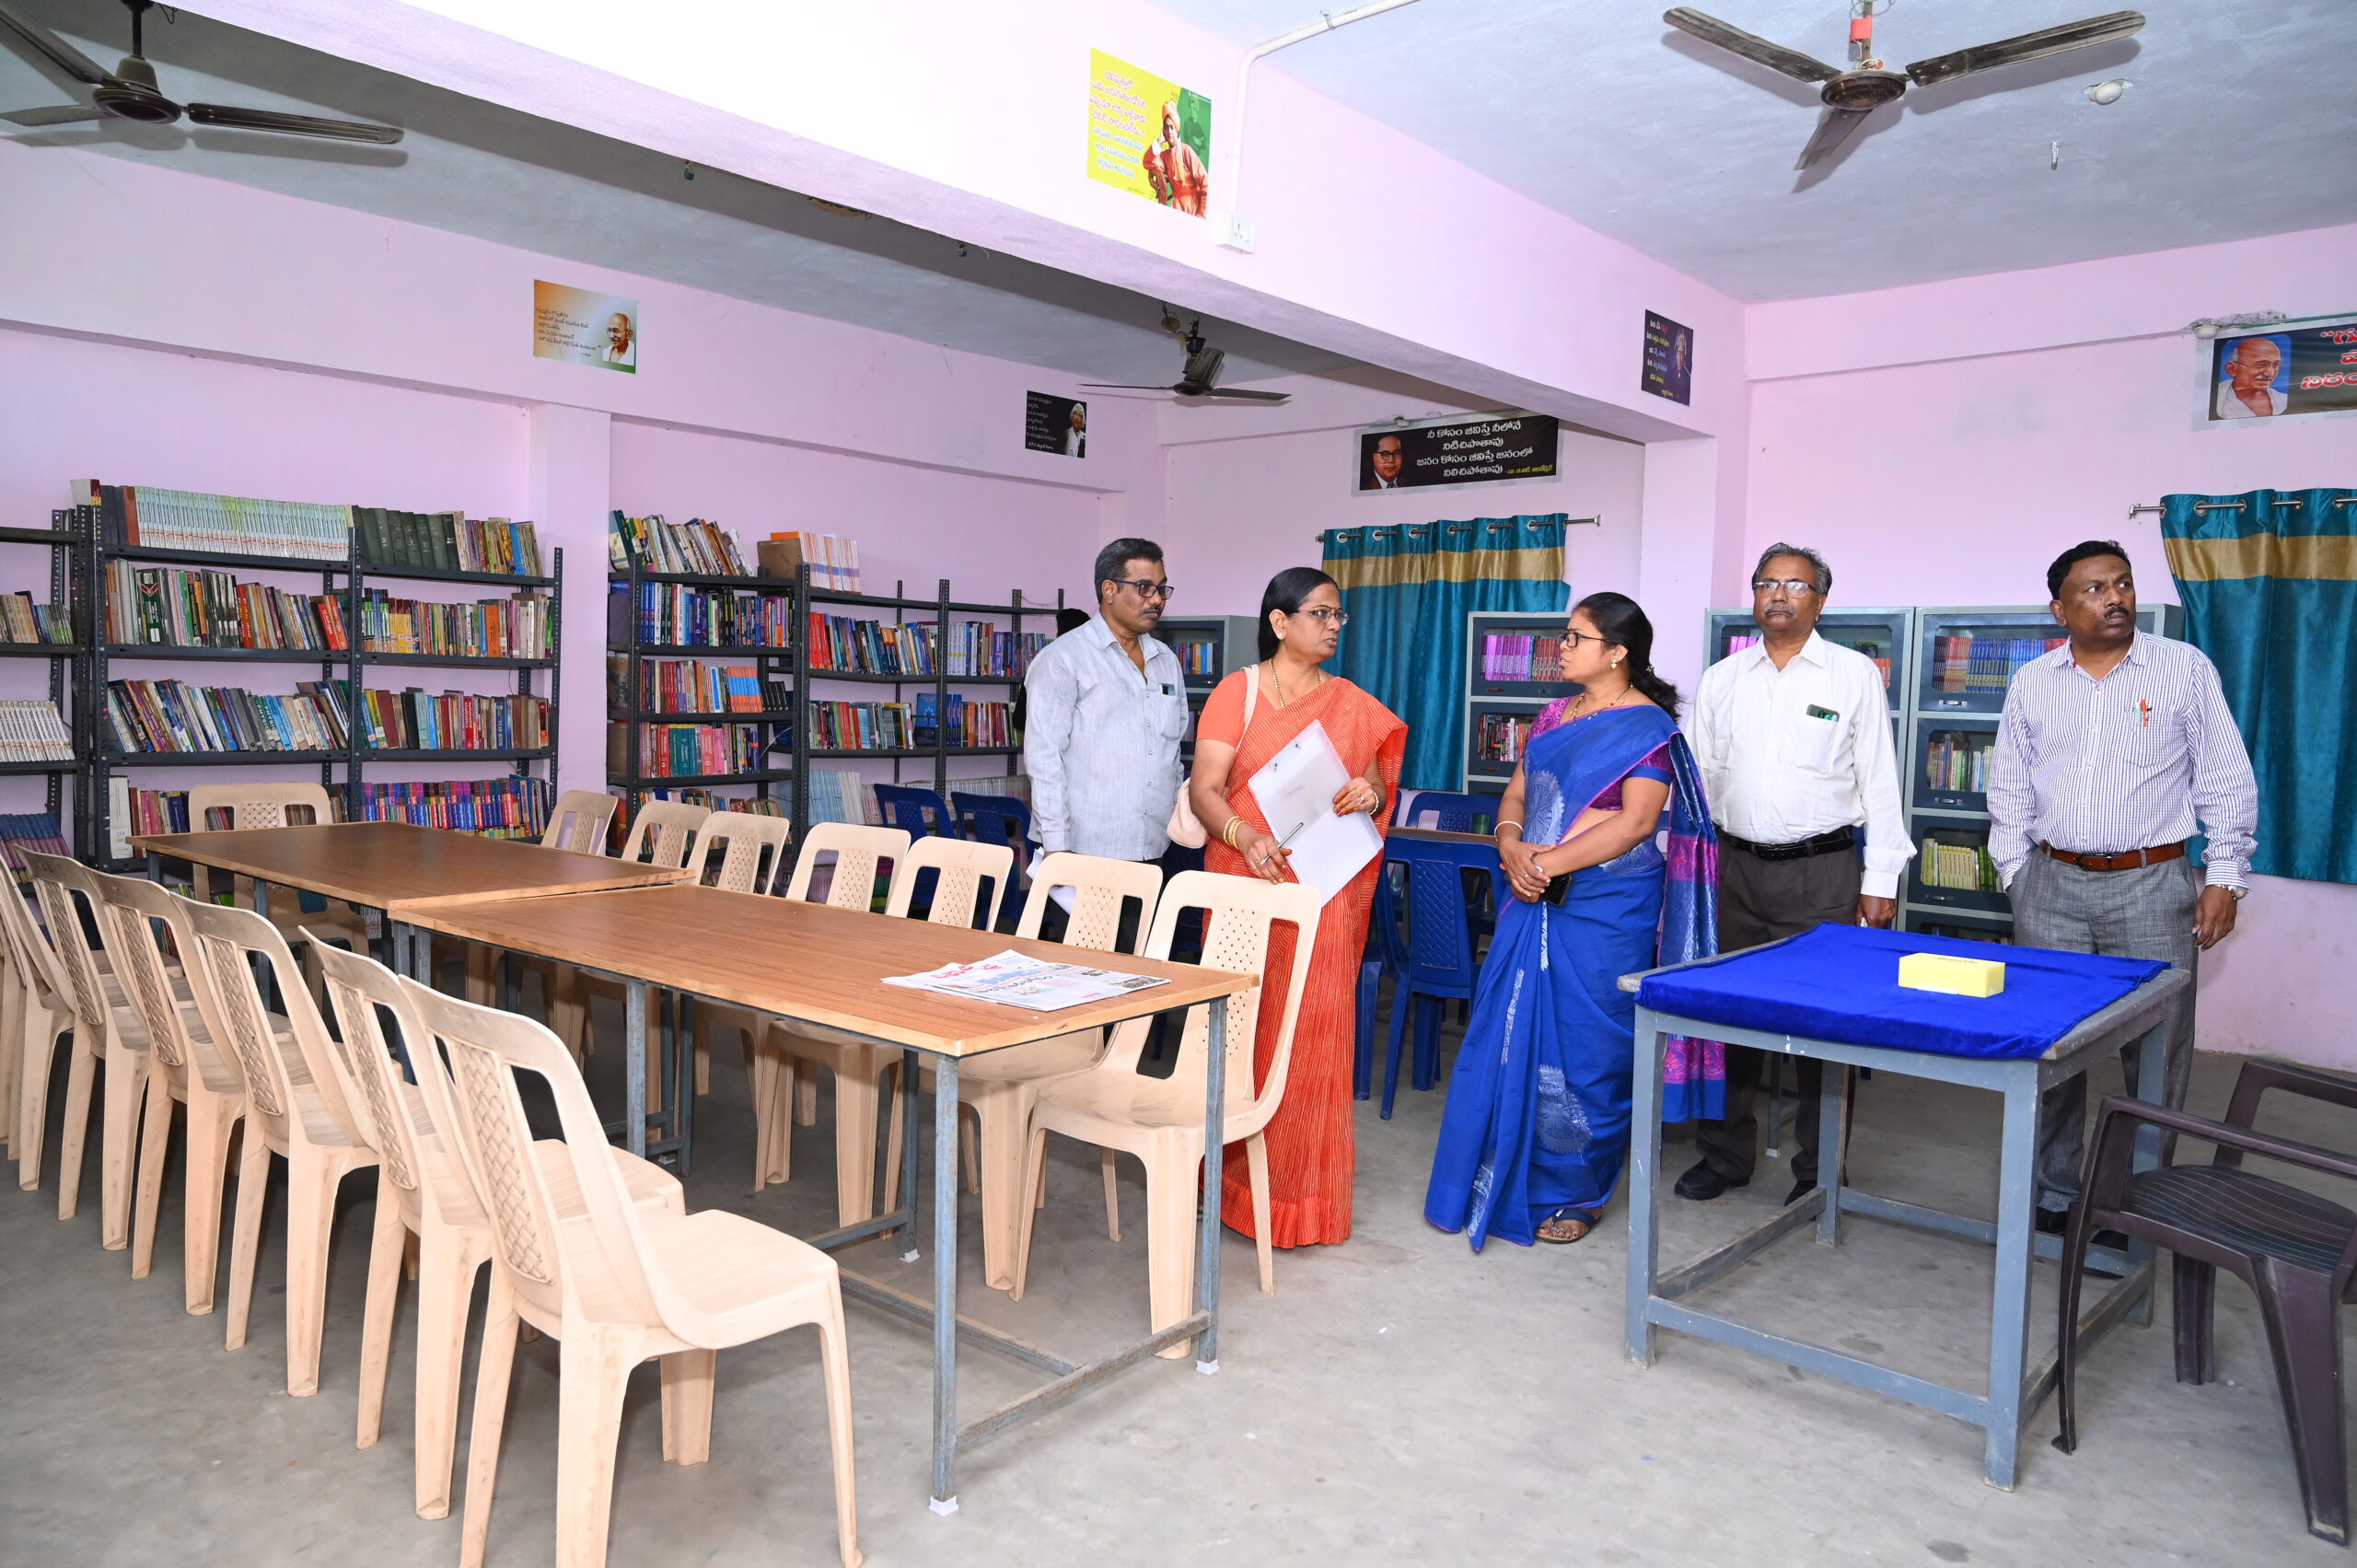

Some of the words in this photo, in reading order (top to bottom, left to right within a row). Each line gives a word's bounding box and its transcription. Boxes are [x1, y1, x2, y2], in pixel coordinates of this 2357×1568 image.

[1427, 429, 1435, 439] నీ
[1436, 428, 1463, 438] కోసం
[1465, 423, 1491, 436] జీవిస్తే
[1492, 420, 1522, 433] నీలోనే
[1416, 458, 1439, 466] జనం
[1441, 454, 1467, 464] కోసం
[1469, 449, 1494, 462] జీవిస్తే
[1496, 447, 1533, 459] జనంలో
[257, 704, 269, 730] PHYSIC
[264, 705, 275, 730] PHYSIC
